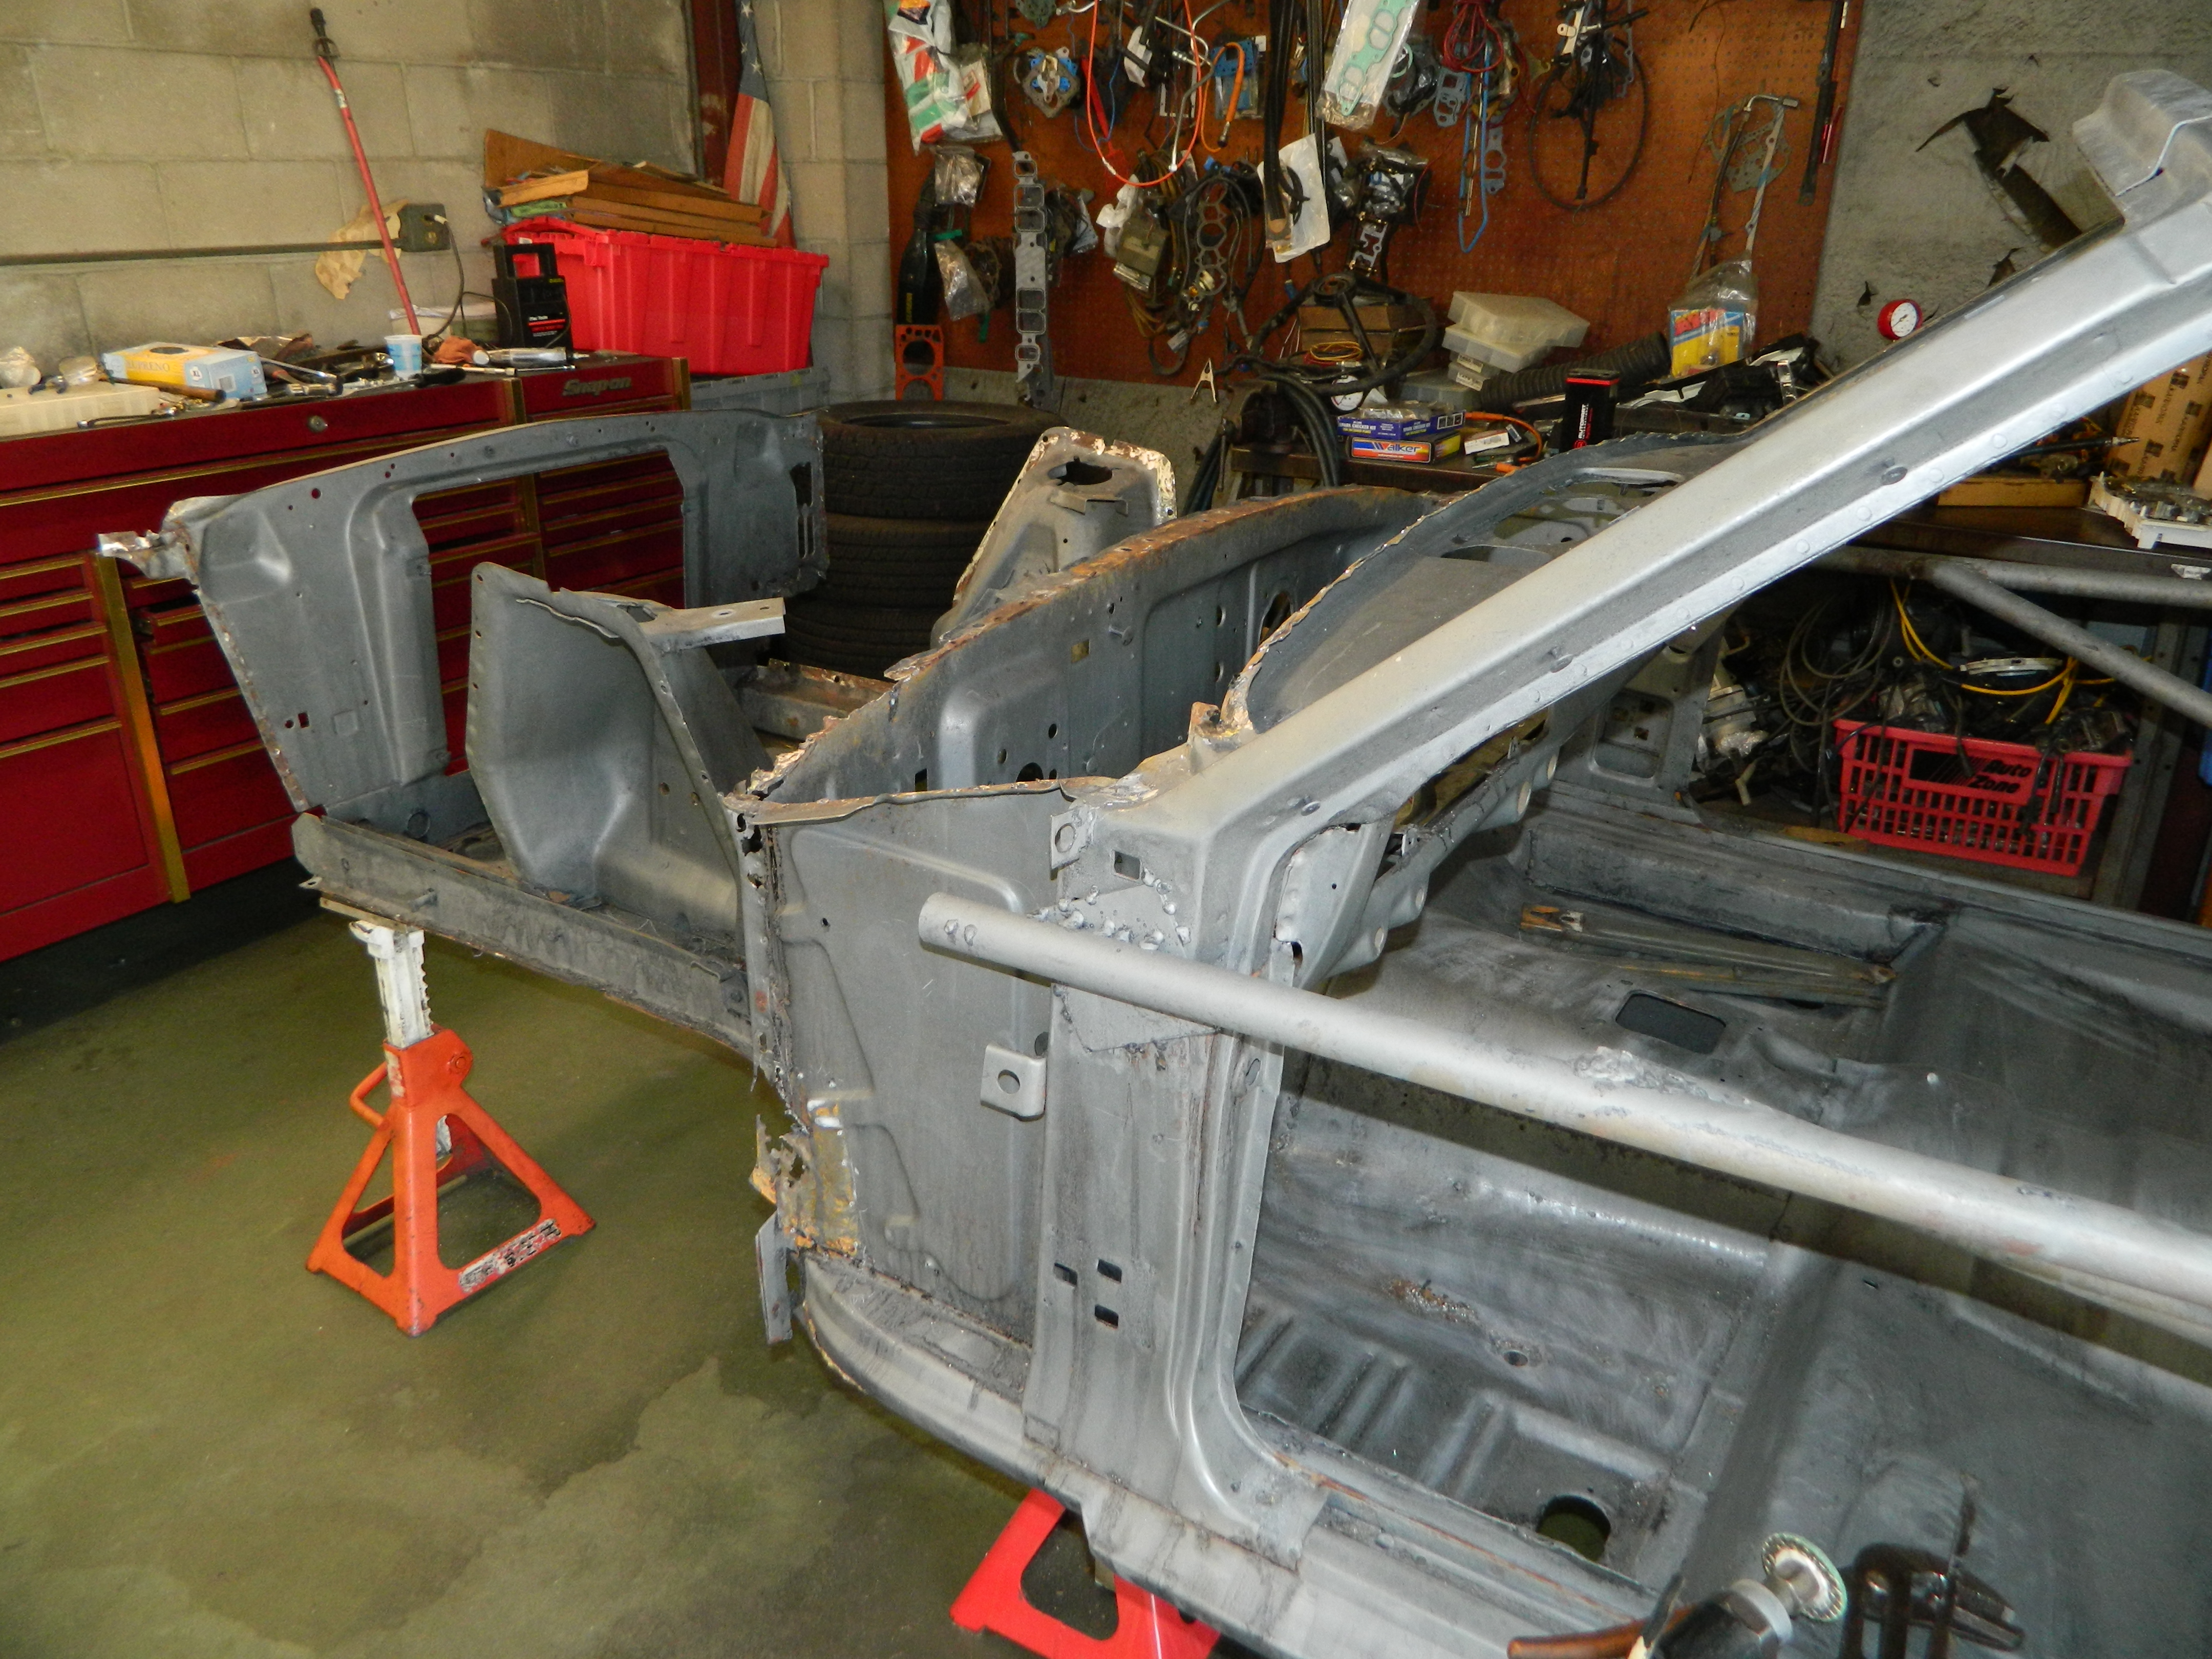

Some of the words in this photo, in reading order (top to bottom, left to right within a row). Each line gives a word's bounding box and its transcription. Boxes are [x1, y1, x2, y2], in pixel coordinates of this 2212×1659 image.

[562, 376, 632, 396] Snap-on
[1373, 441, 1422, 453] Walker
[1982, 760, 2032, 777] Auto
[1968, 775, 2020, 793] Zone
